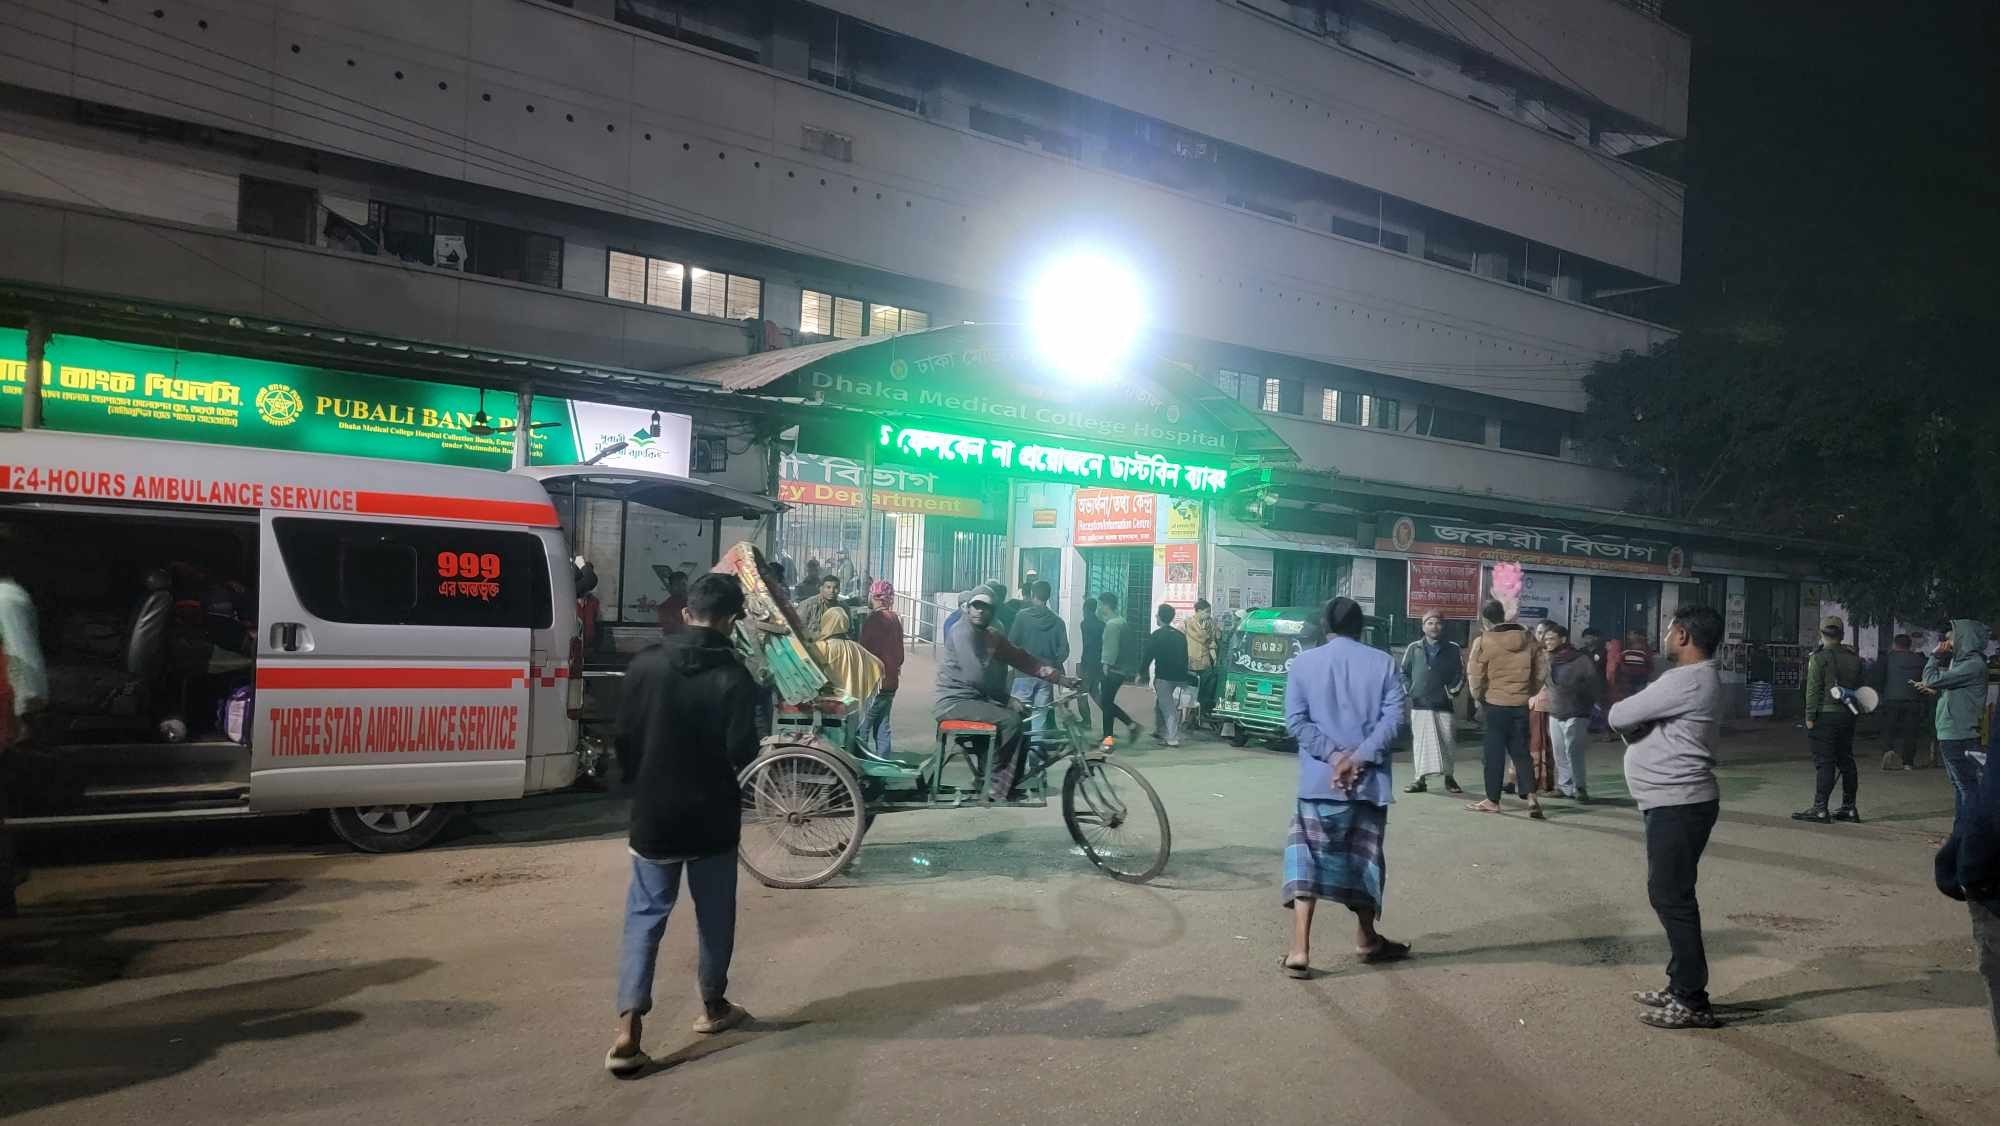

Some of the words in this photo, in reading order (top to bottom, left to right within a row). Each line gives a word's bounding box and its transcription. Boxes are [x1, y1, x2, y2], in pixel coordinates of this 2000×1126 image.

[315, 396, 414, 425] PUBALI
[812, 371, 908, 401] Dhaka
[919, 389, 1029, 419] Medical
[1035, 407, 1127, 435] College
[1134, 422, 1226, 447] Hospital
[990, 439, 1016, 468] না
[13, 466, 126, 497] 24-HOURS
[132, 474, 264, 506] AMBULANCE
[269, 485, 354, 512] SERVICE
[816, 456, 940, 493] বিভাগ
[815, 484, 961, 511] Department
[1431, 525, 1549, 551] জরুরী
[1557, 533, 1658, 562] বিভাগ
[437, 551, 501, 579] 999
[438, 581, 457, 598] এর
[270, 708, 322, 757] THREE
[322, 707, 363, 754] STAR
[364, 706, 457, 753] AMBULANCE
[457, 705, 518, 752] SERVICE
